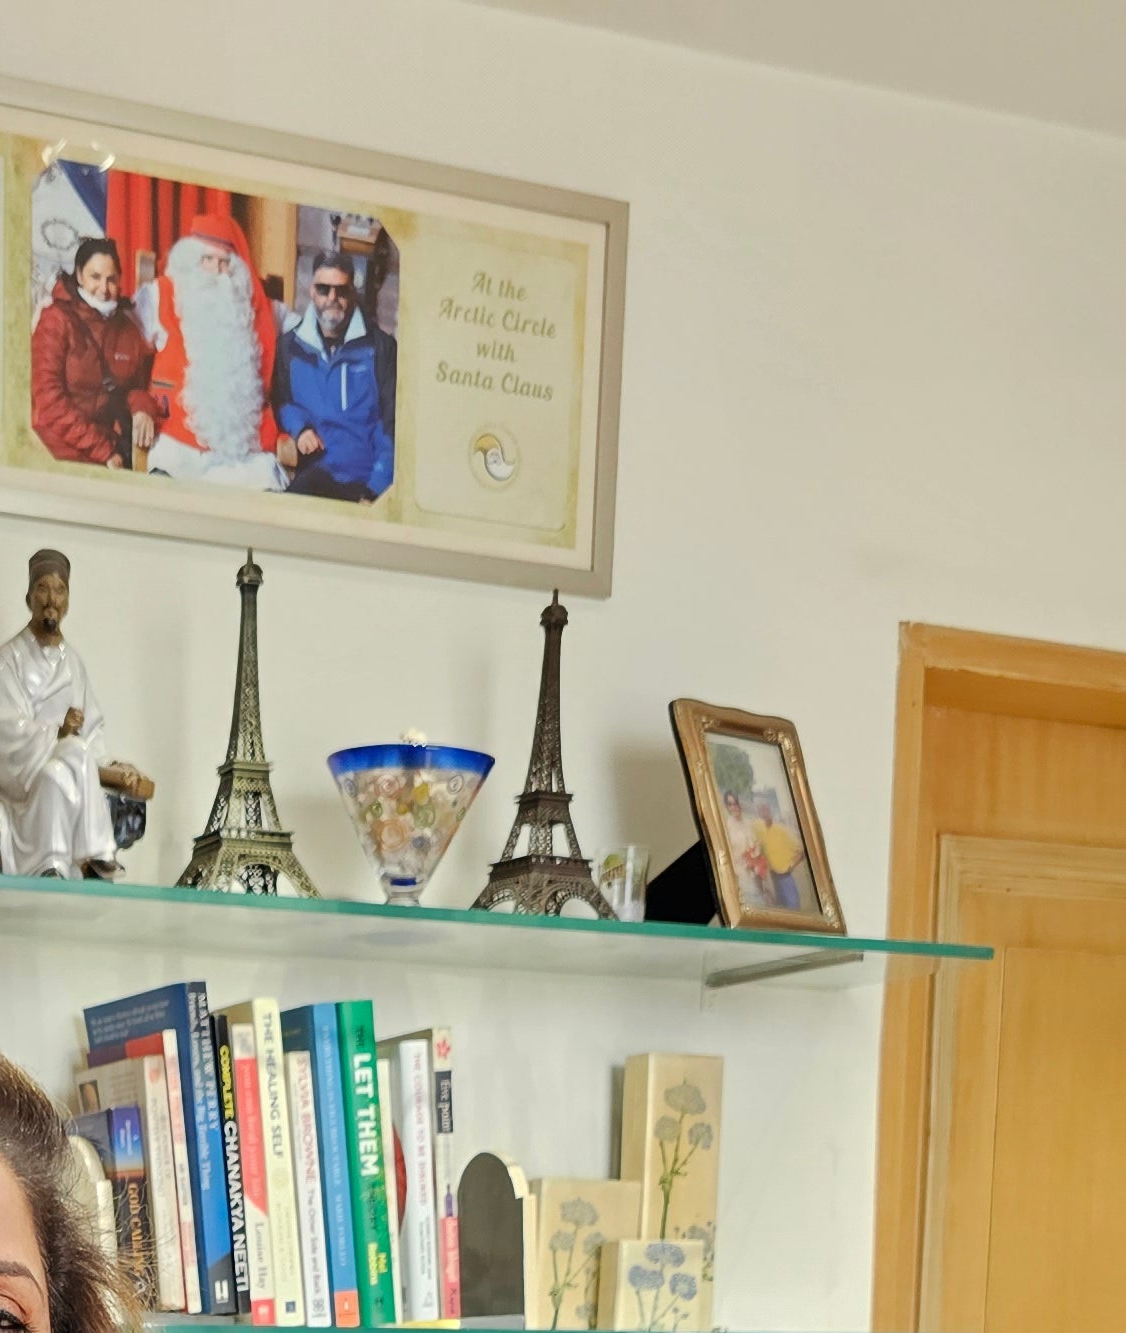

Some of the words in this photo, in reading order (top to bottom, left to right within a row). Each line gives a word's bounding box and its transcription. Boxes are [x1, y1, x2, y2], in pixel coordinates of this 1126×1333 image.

[472, 271, 492, 295] At
[498, 280, 527, 301] the
[439, 298, 495, 328] Arctic
[502, 309, 557, 338] Circle
[477, 341, 516, 363] with
[435, 361, 494, 392] Santa
[501, 372, 554, 401] Claus
[262, 1012, 274, 1042] THE
[197, 991, 215, 1077] MATTHEW
[206, 1080, 220, 1131] PERRY
[353, 1052, 376, 1099] LET
[413, 1053, 422, 1071] THE
[218, 1044, 236, 1120] COMPLETE
[265, 1049, 282, 1121] HEALING
[296, 1057, 311, 1107] SYLVIA
[439, 1079, 452, 1100] five
[414, 1074, 424, 1125] COURAGE
[437, 1101, 453, 1134] point
[270, 1125, 284, 1158] SELF
[301, 1113, 318, 1184] BROWNE
[357, 1103, 381, 1177] THEM
[416, 1128, 425, 1143] TO
[418, 1146, 427, 1158] BE
[201, 1163, 212, 1190] Thing
[223, 1120, 246, 1232] CHANAKYA
[127, 1182, 141, 1214] GOD
[307, 1188, 316, 1206] The
[308, 1208, 320, 1235] Other
[254, 1222, 266, 1263] Louise
[311, 1236, 321, 1254] Side
[232, 1234, 250, 1292] NEETI
[256, 1266, 269, 1290] Hay
[312, 1256, 321, 1272] and
[368, 1242, 379, 1286] Robbins
[378, 1252, 388, 1274] Mel
[314, 1274, 324, 1294] Back
